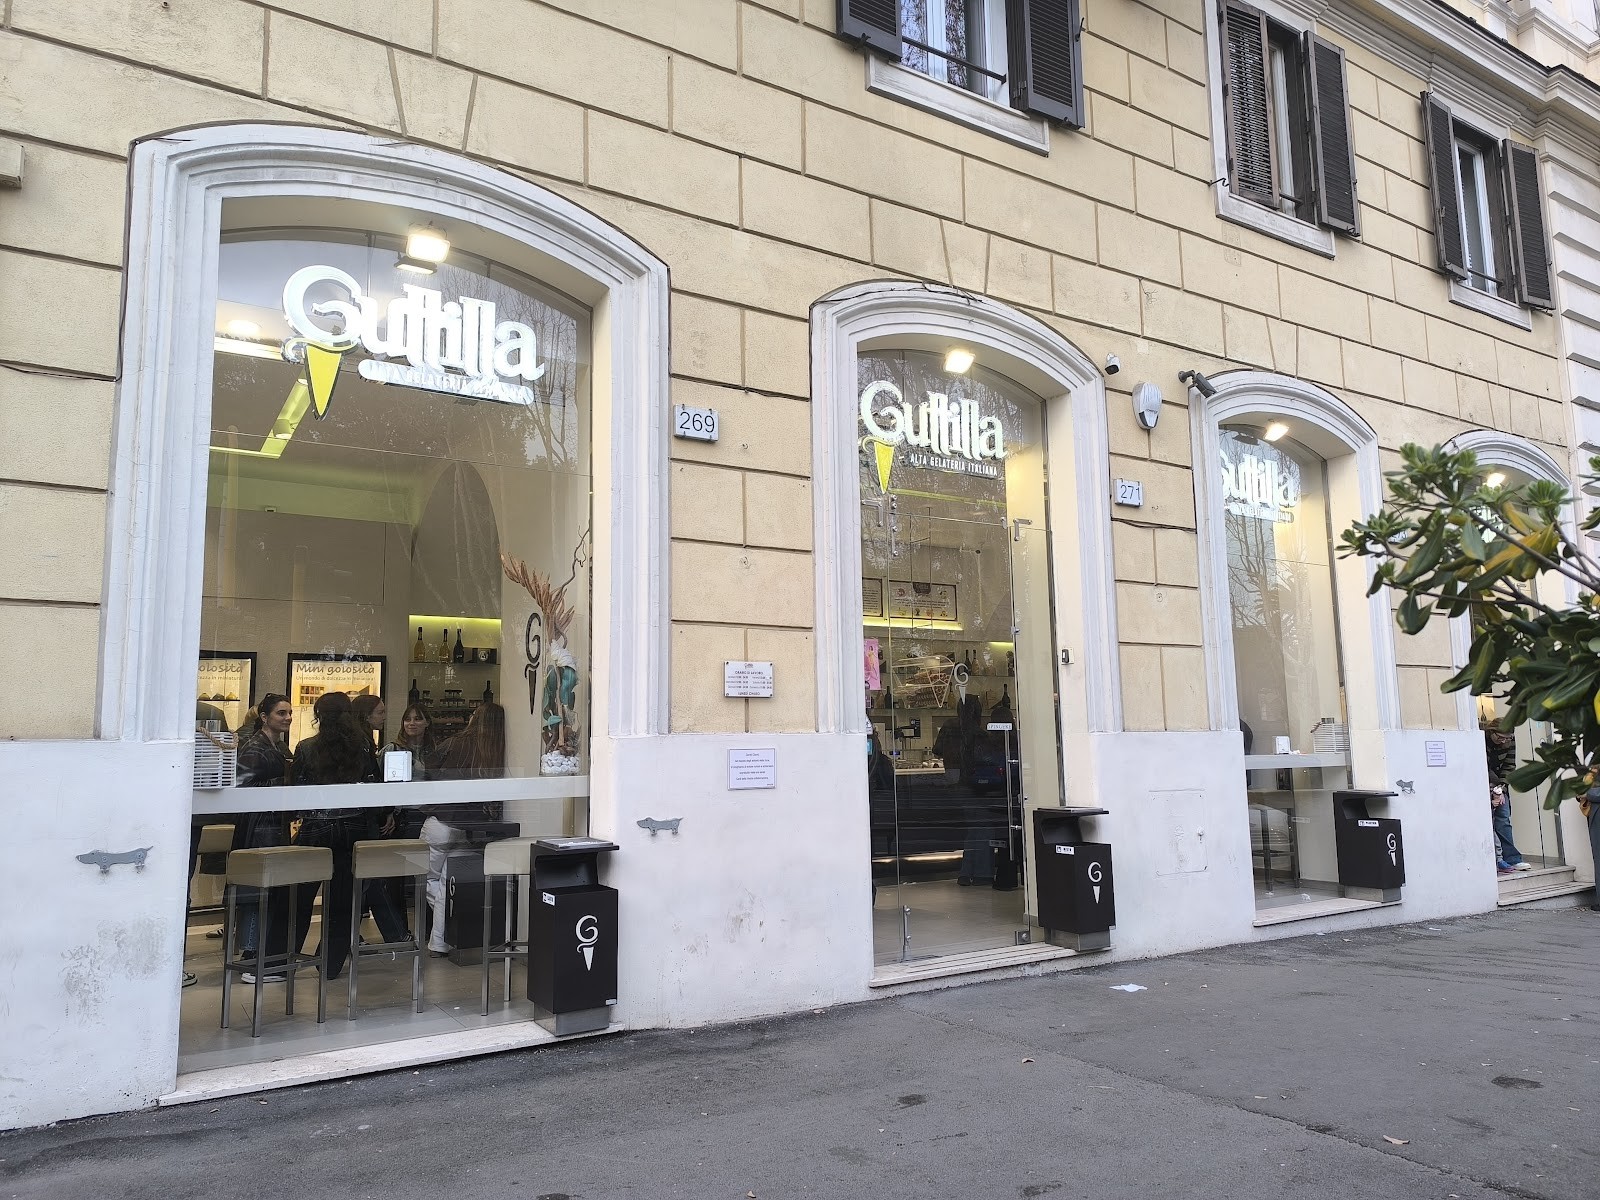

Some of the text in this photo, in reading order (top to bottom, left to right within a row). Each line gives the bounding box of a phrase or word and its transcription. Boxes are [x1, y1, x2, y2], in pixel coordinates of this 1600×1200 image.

[282, 264, 546, 381] Guttilla
[679, 411, 715, 433] 269
[860, 379, 1009, 461] Guttilla
[910, 453, 998, 476] ALTA GELATERIA ITALIANA
[1120, 484, 1141, 501] 271
[198, 662, 243, 673] olosità
[296, 663, 375, 676] Mini golosità
